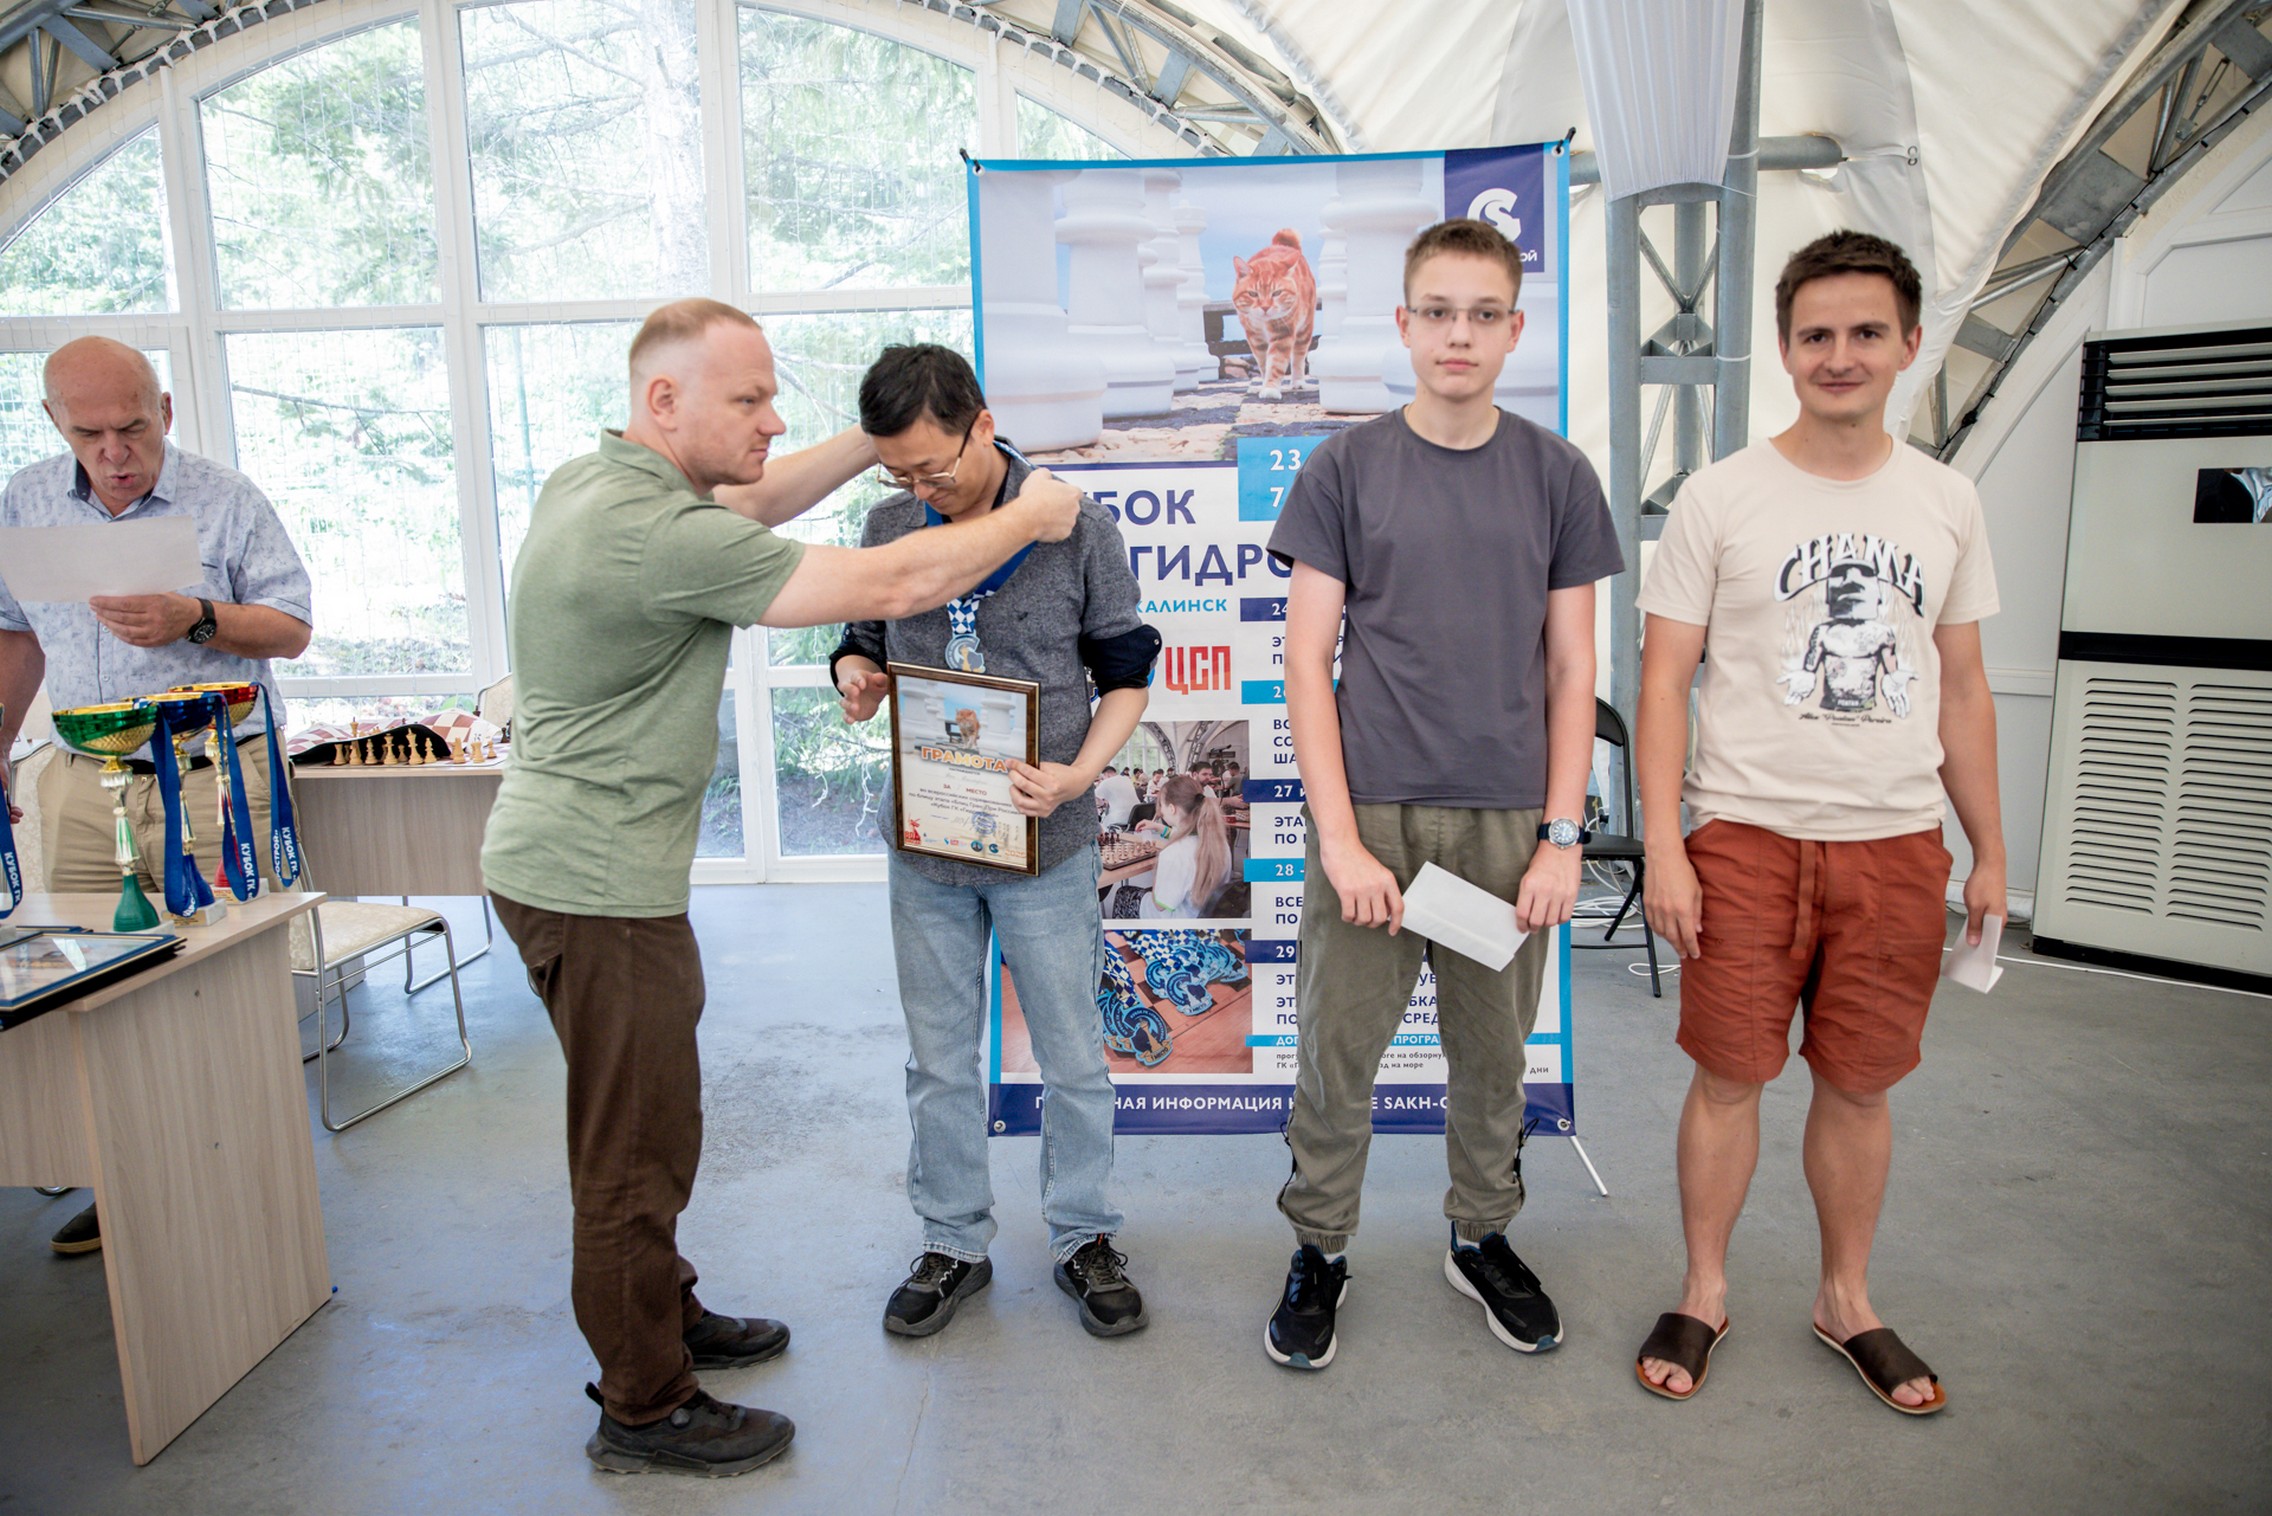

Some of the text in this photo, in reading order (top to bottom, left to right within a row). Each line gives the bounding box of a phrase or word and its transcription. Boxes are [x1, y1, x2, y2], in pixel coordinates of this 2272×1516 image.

[1269, 449, 1302, 471] 23
[1083, 489, 1196, 526] БОК
[1774, 533, 1926, 618] CHAMA
[1165, 646, 1231, 695] ЦСП
[921, 747, 1008, 773] ГРАМОТА
[1274, 785, 1293, 798] 27
[1274, 816, 1306, 827] ЭТА
[1274, 833, 1297, 844] ПО
[240, 843, 255, 878] КУБОК
[1275, 864, 1294, 876] 28
[1276, 913, 1298, 924] ПО
[1276, 946, 1295, 958] 29
[1409, 1052, 1445, 1060] обзорну
[1152, 1096, 1282, 1112] ИНФОРМАЦИЯ
